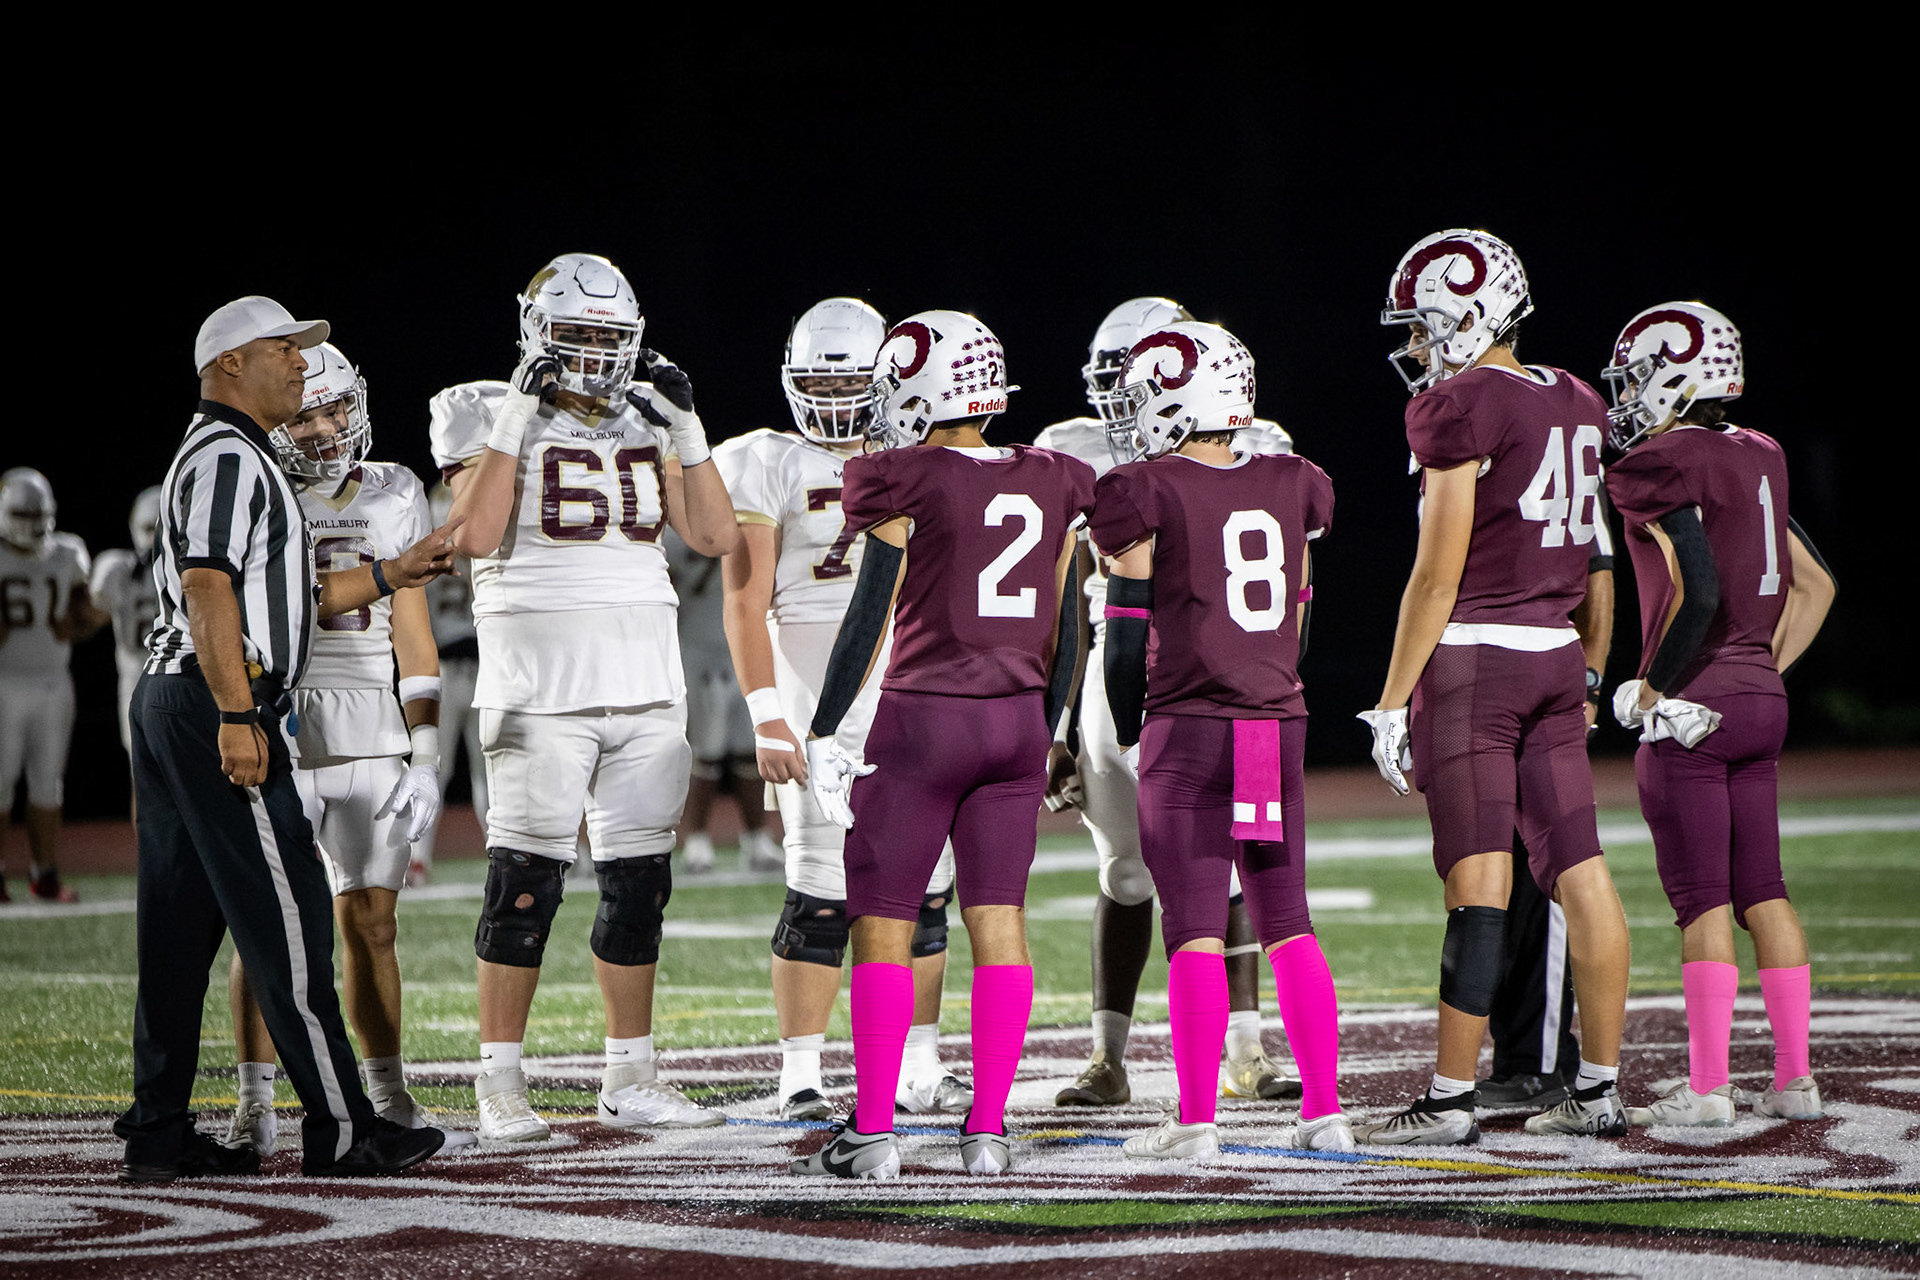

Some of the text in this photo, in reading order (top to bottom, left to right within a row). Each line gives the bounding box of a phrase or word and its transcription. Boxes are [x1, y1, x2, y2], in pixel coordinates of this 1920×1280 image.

[988, 361, 999, 387] 2
[570, 430, 625, 440] MILLBURY
[1518, 425, 1602, 547] 46
[310, 520, 369, 529] MILLBURY
[541, 446, 668, 543] 60
[1758, 475, 1780, 595] 1
[978, 493, 1043, 617] 2
[1222, 509, 1286, 632] 8
